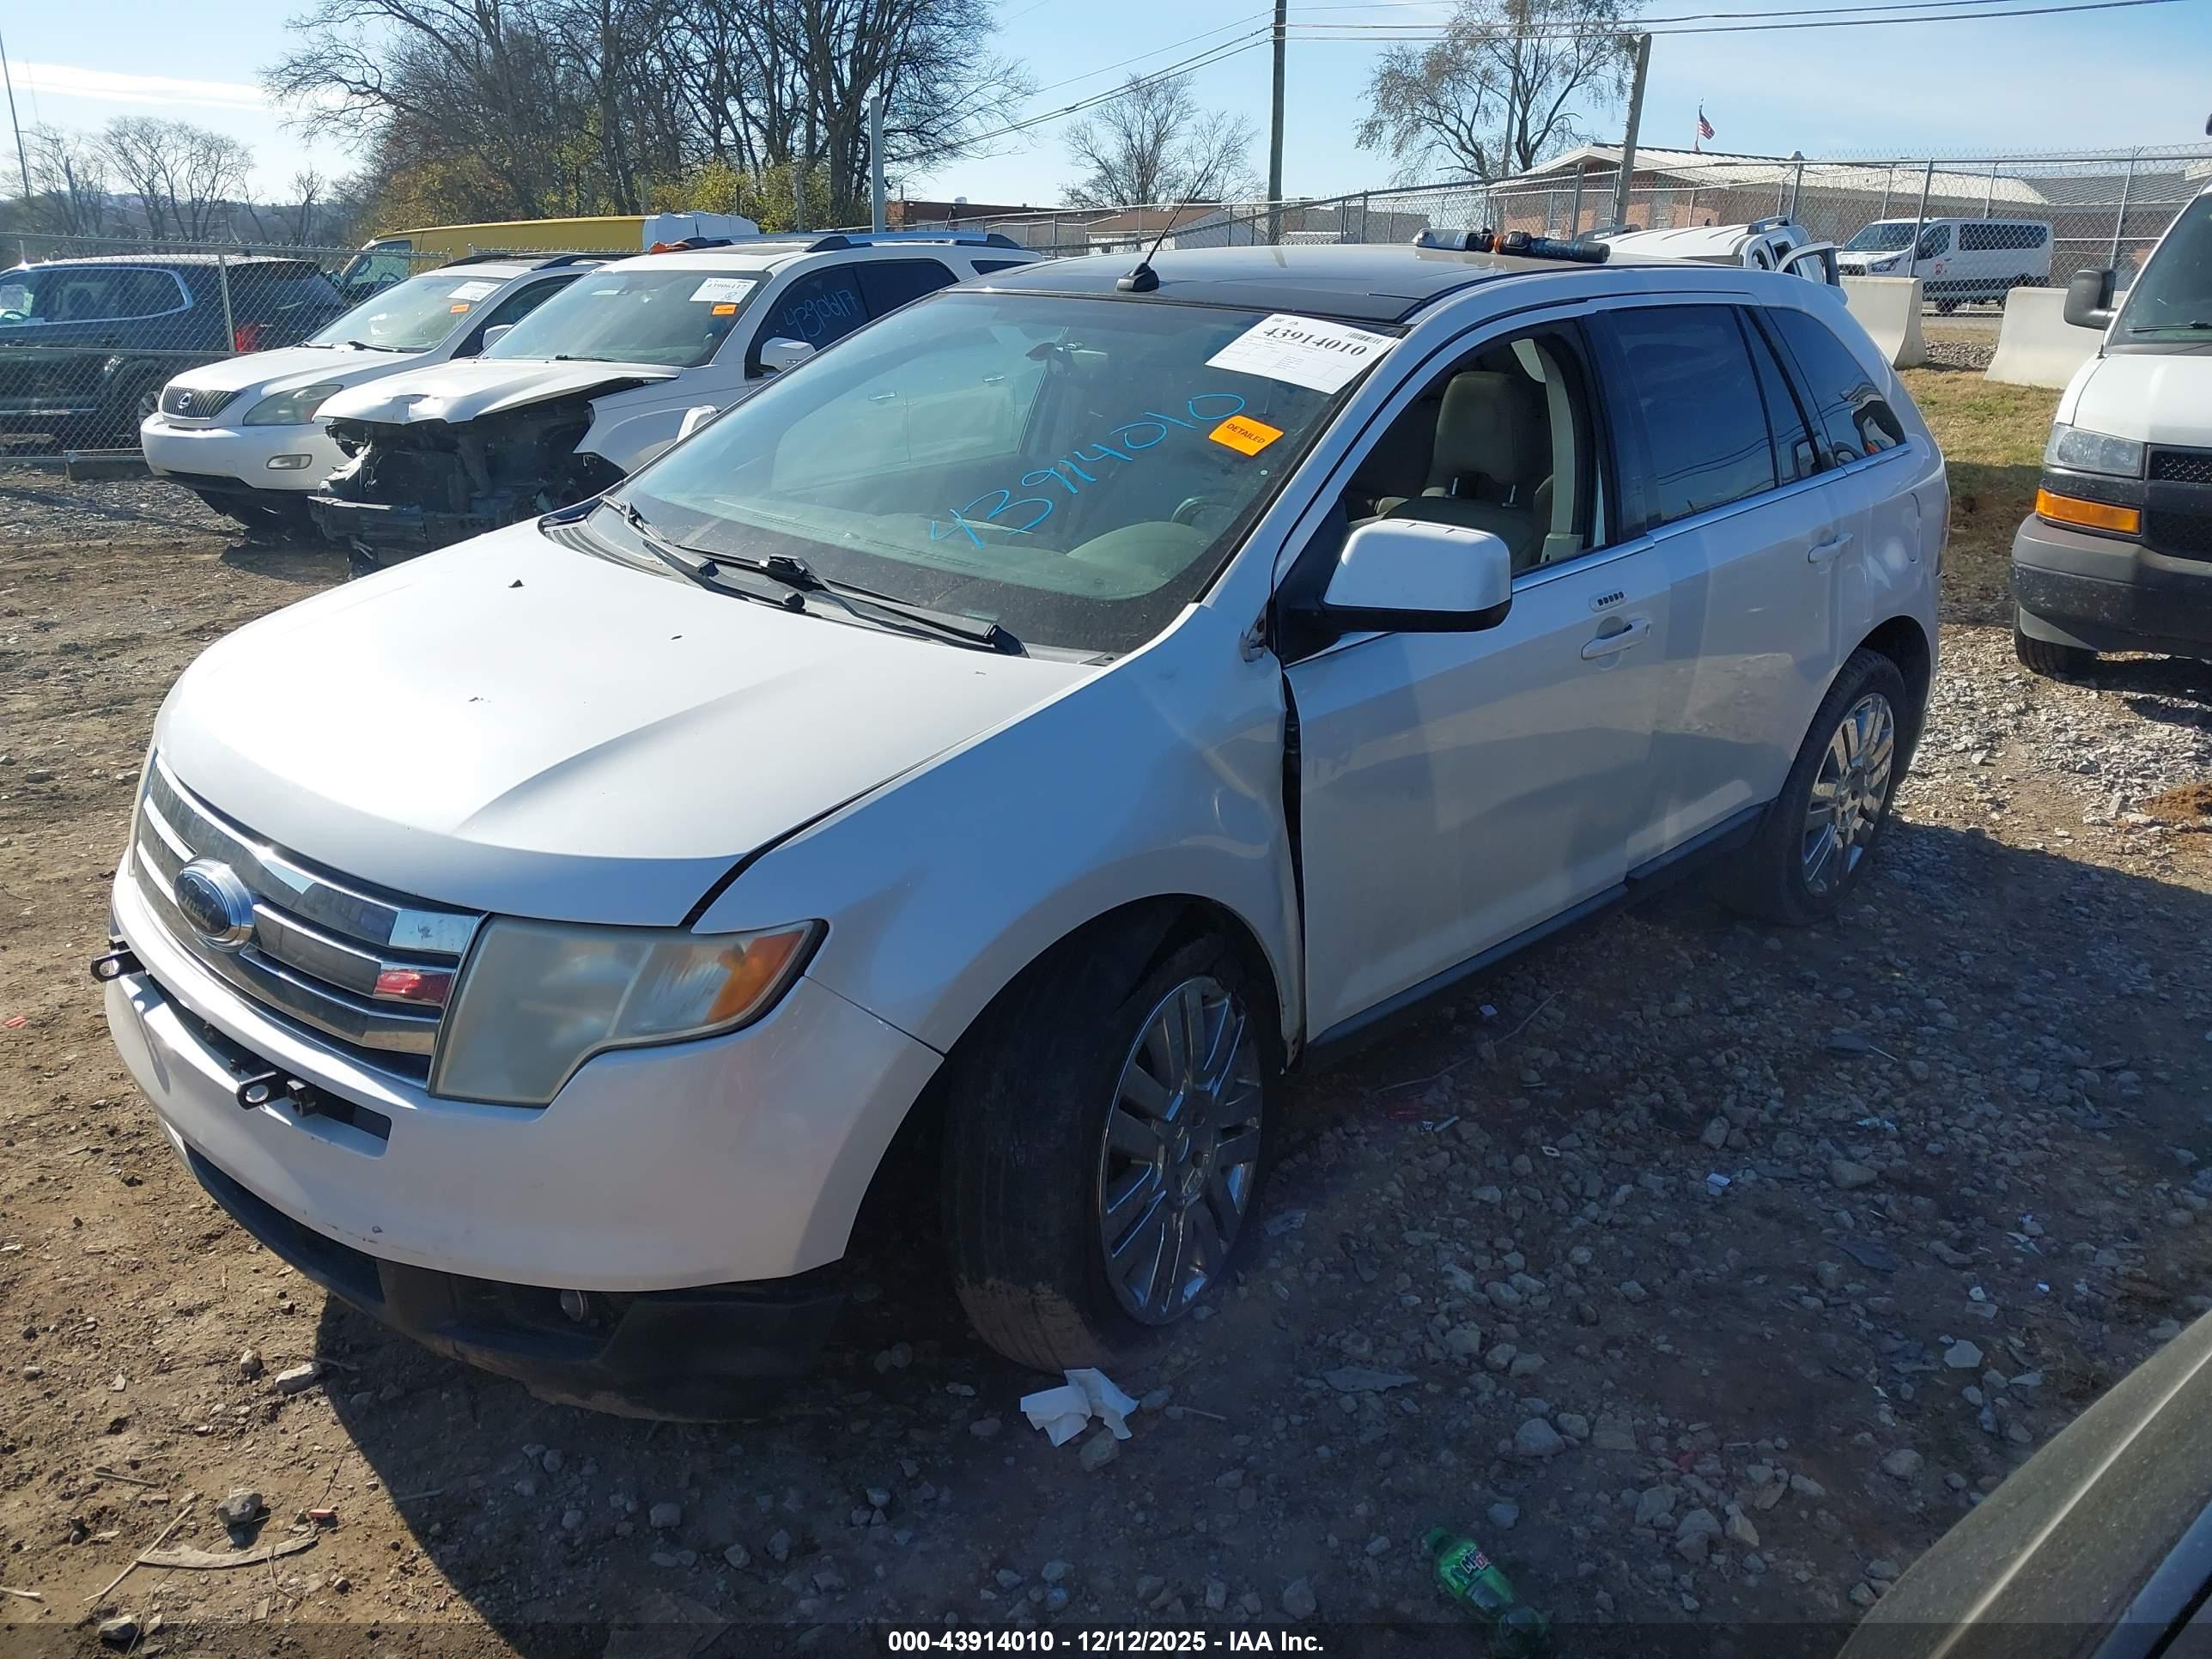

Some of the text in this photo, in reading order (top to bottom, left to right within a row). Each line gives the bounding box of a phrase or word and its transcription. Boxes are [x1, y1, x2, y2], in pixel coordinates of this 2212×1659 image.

[1263, 327, 1368, 356] 43914010
[1226, 422, 1266, 444] DETAILED
[931, 393, 1245, 550] 43914010
